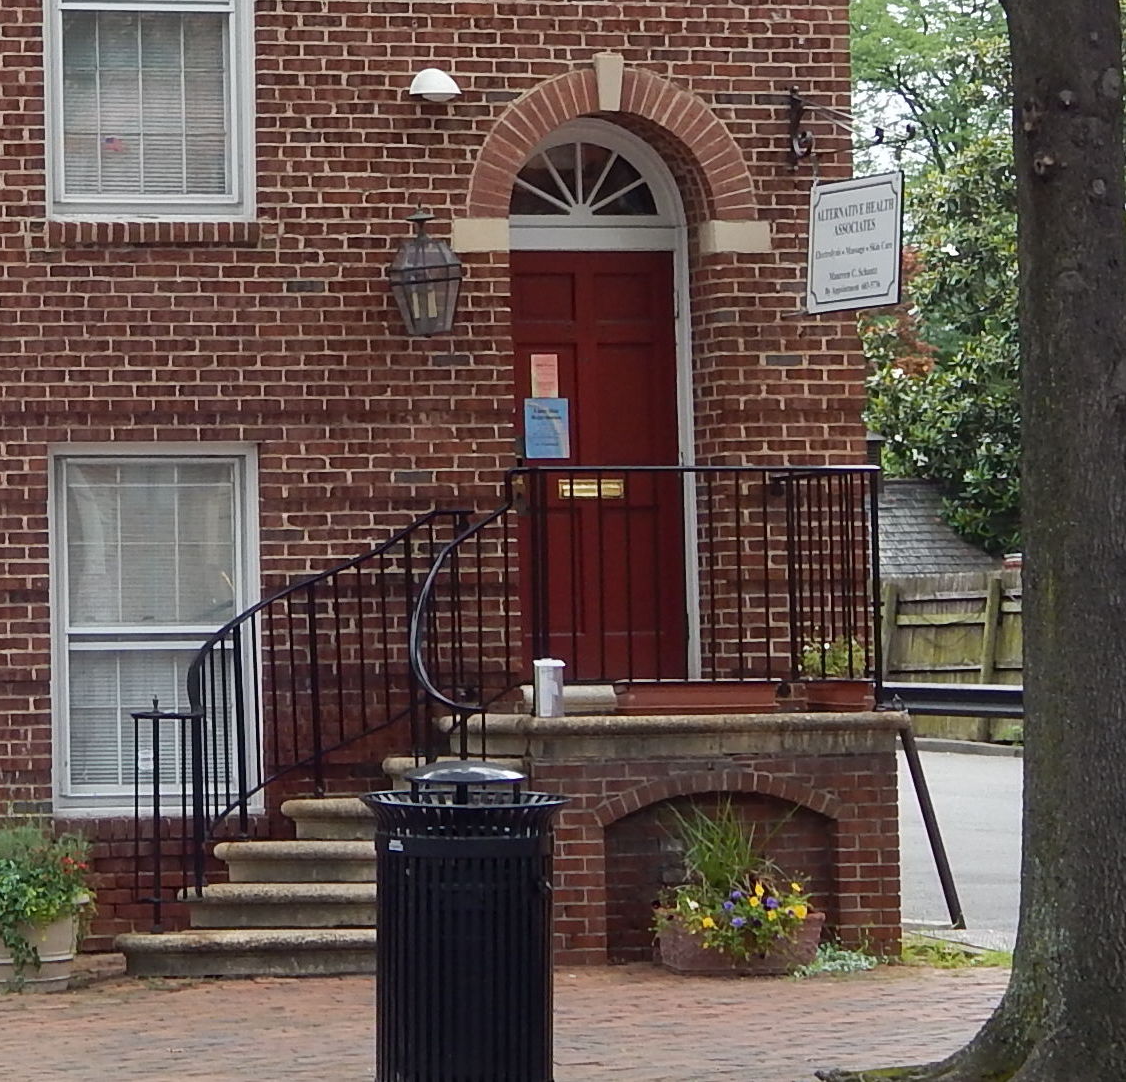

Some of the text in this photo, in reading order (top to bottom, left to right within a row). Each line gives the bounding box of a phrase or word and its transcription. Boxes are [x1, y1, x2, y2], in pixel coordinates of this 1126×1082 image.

[817, 198, 894, 222] ALTERNATIVE HEALTH
[834, 218, 876, 236] ASSOCIATES
